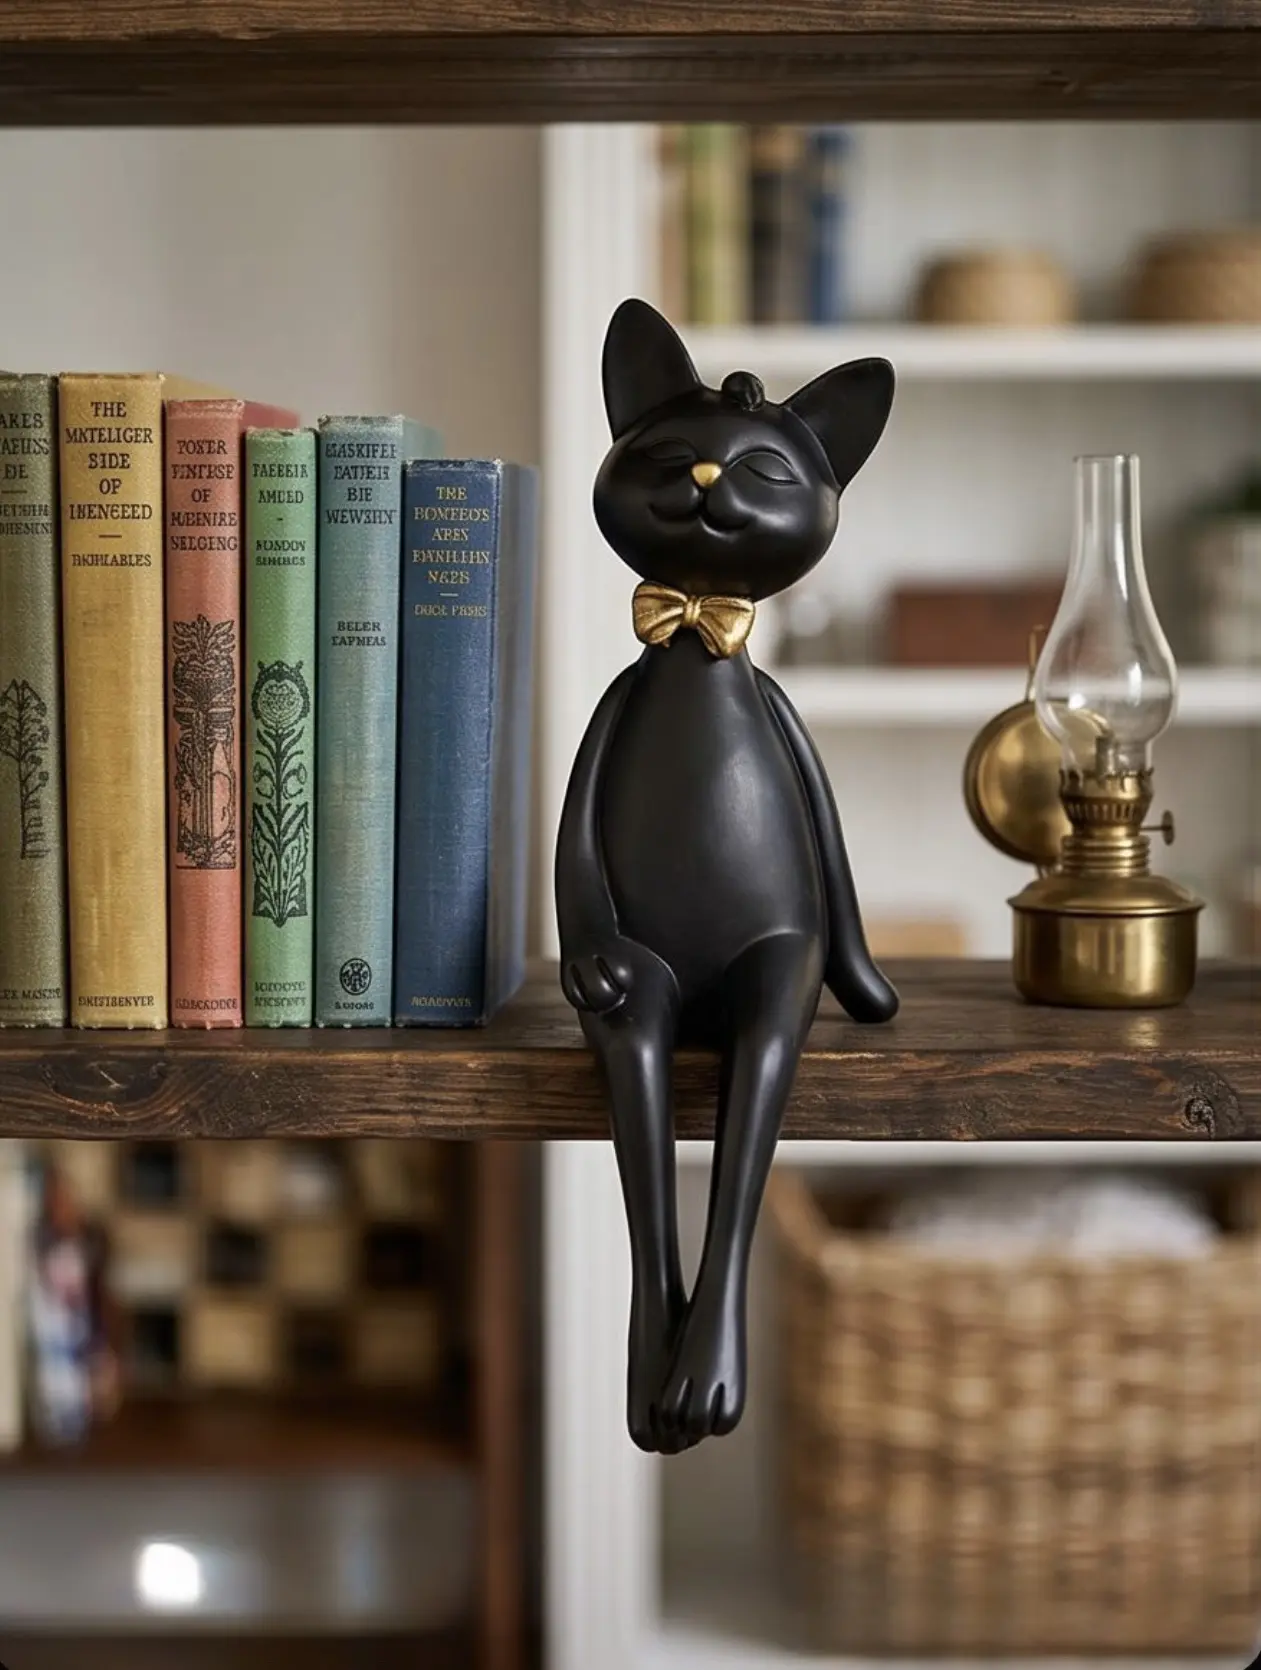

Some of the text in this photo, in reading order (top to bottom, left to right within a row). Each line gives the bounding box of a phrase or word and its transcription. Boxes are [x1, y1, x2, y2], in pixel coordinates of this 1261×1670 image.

[91, 401, 127, 417] THE
[88, 452, 130, 469] SIDE
[191, 488, 212, 503] OF
